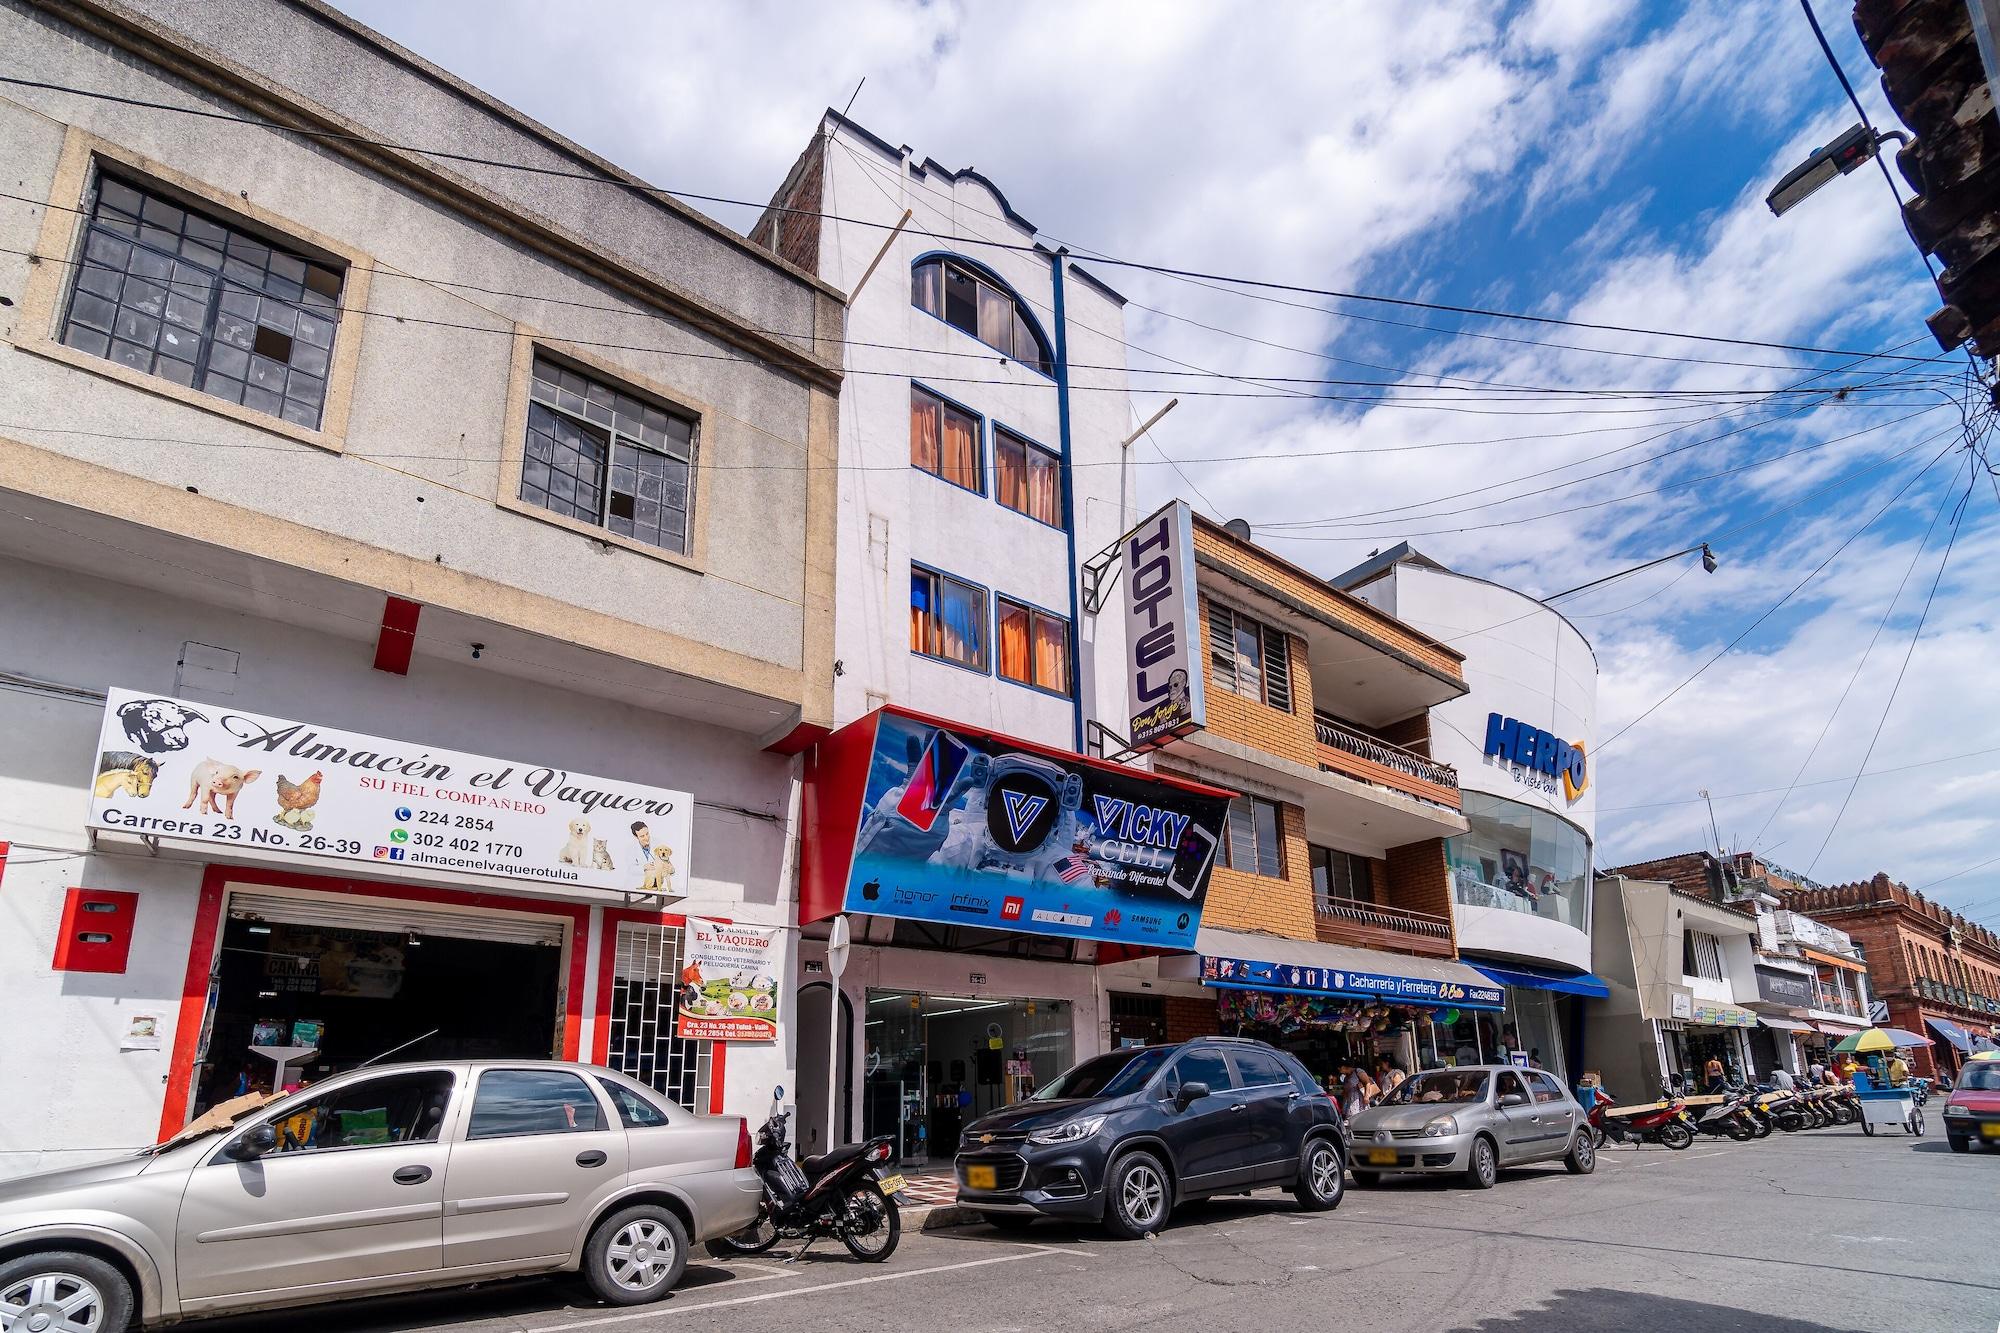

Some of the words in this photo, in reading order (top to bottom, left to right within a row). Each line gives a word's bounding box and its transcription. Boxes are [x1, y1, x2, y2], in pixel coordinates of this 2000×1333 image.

[1131, 517, 1176, 703] HOTEL
[1132, 716, 1152, 732] Don
[1150, 703, 1178, 726] Jorge
[1484, 712, 1587, 791] HERPO
[220, 714, 455, 782] Almacén
[469, 767, 514, 790] el
[523, 767, 675, 817] Vaquero
[359, 776, 386, 791] SU
[392, 782, 430, 798] FIEL
[435, 788, 547, 816] COMPAÑERO
[102, 808, 204, 835] Carrera
[211, 823, 242, 839] 23
[250, 827, 291, 847] No.
[297, 834, 362, 855] 26-39
[418, 810, 450, 826] 224
[454, 815, 495, 832] 2854
[1093, 794, 1191, 849] VICKY
[412, 832, 444, 849] 302
[449, 837, 480, 853] 402
[485, 841, 523, 858] 1770
[1099, 839, 1166, 869] CELL
[410, 850, 579, 881] almacenelvaquerotulua
[1087, 864, 1128, 880] Pensando
[1128, 871, 1166, 887] Diferente!
[894, 885, 940, 903] honor
[951, 893, 992, 908] Infinix
[1035, 912, 1090, 926] ALCATEL
[1130, 914, 1162, 926] SAMSUNG
[696, 932, 712, 942] EL
[716, 933, 769, 948] VAQUERO
[690, 953, 732, 962] CONSULTORIO
[733, 957, 766, 966] VETERINARIO
[1396, 981, 1402, 995] y
[1402, 978, 1437, 995] Ferretería
[700, 1021, 708, 1029] 23
